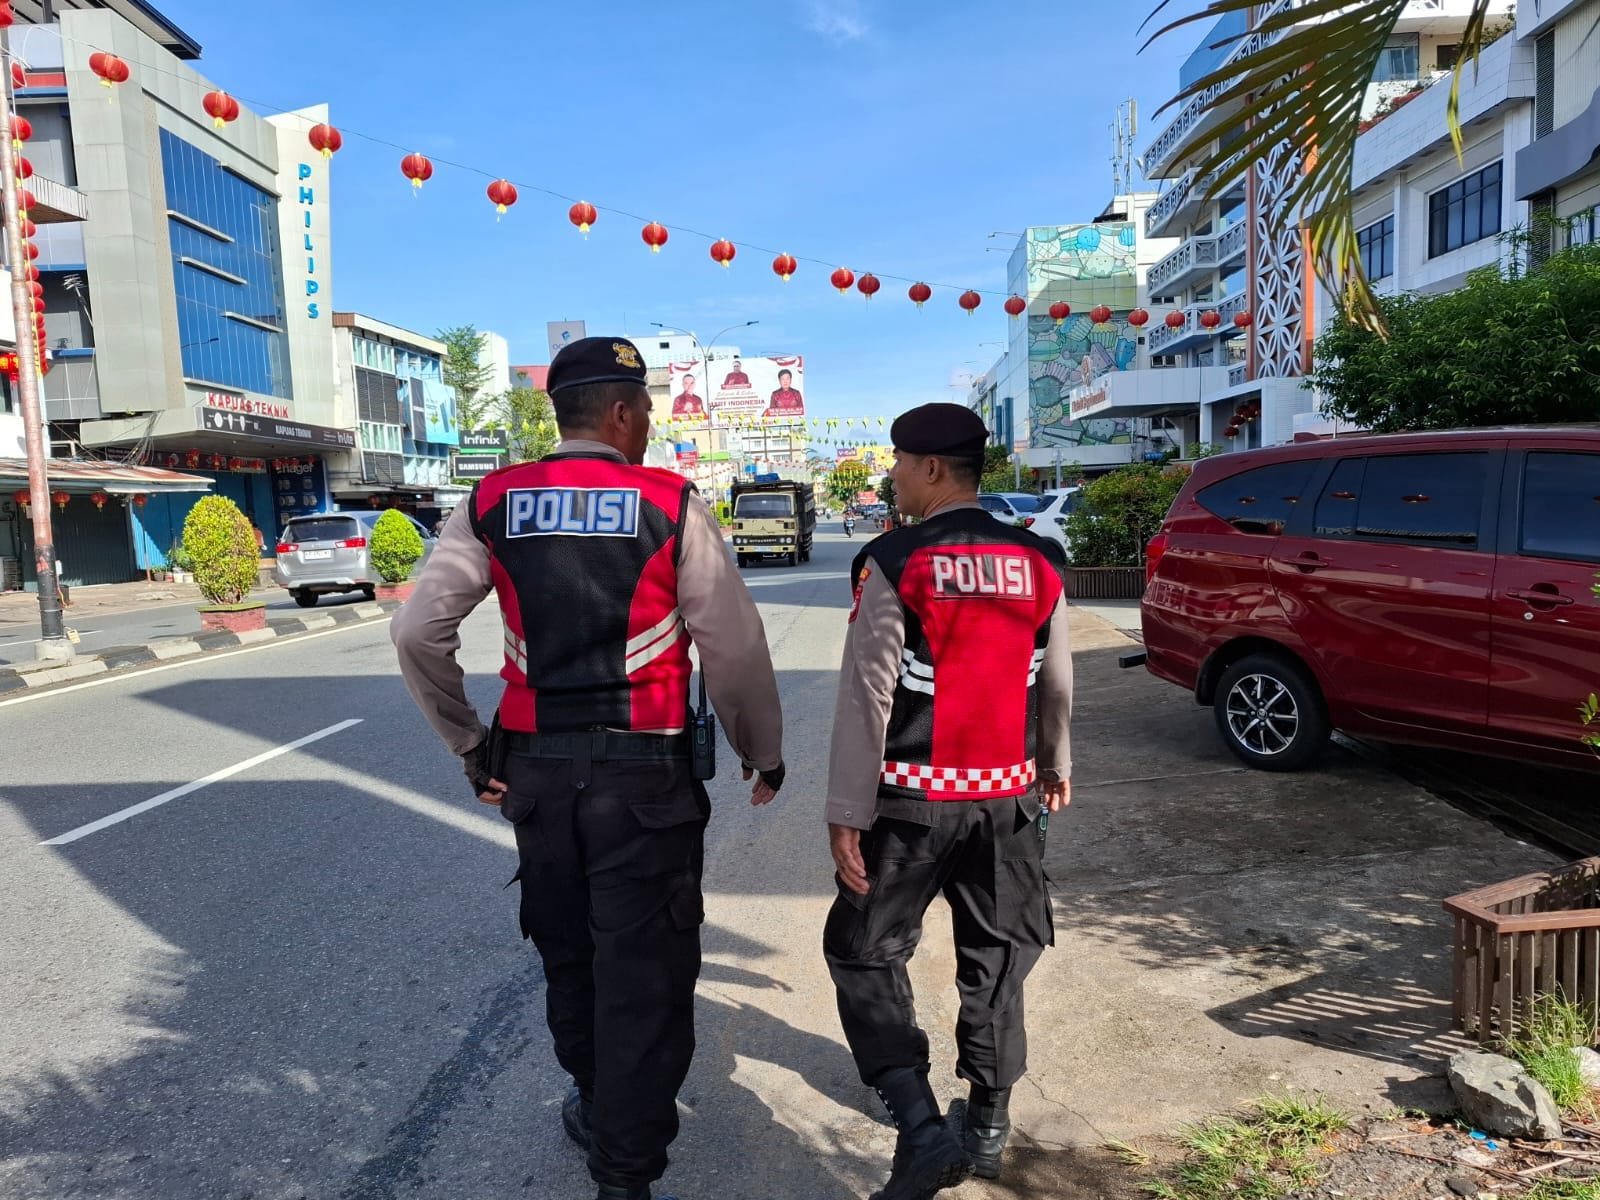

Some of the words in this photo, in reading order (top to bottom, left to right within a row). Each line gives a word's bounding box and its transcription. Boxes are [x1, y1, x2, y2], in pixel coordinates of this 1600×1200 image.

[298, 163, 319, 319] PHILIPS
[207, 392, 253, 413] KAPUAS
[255, 401, 289, 419] TEKNIK
[275, 424, 295, 437] KAPUAS
[464, 435, 501, 445] Infinix
[510, 491, 635, 533] POLISI
[932, 555, 1032, 596] POLISI
